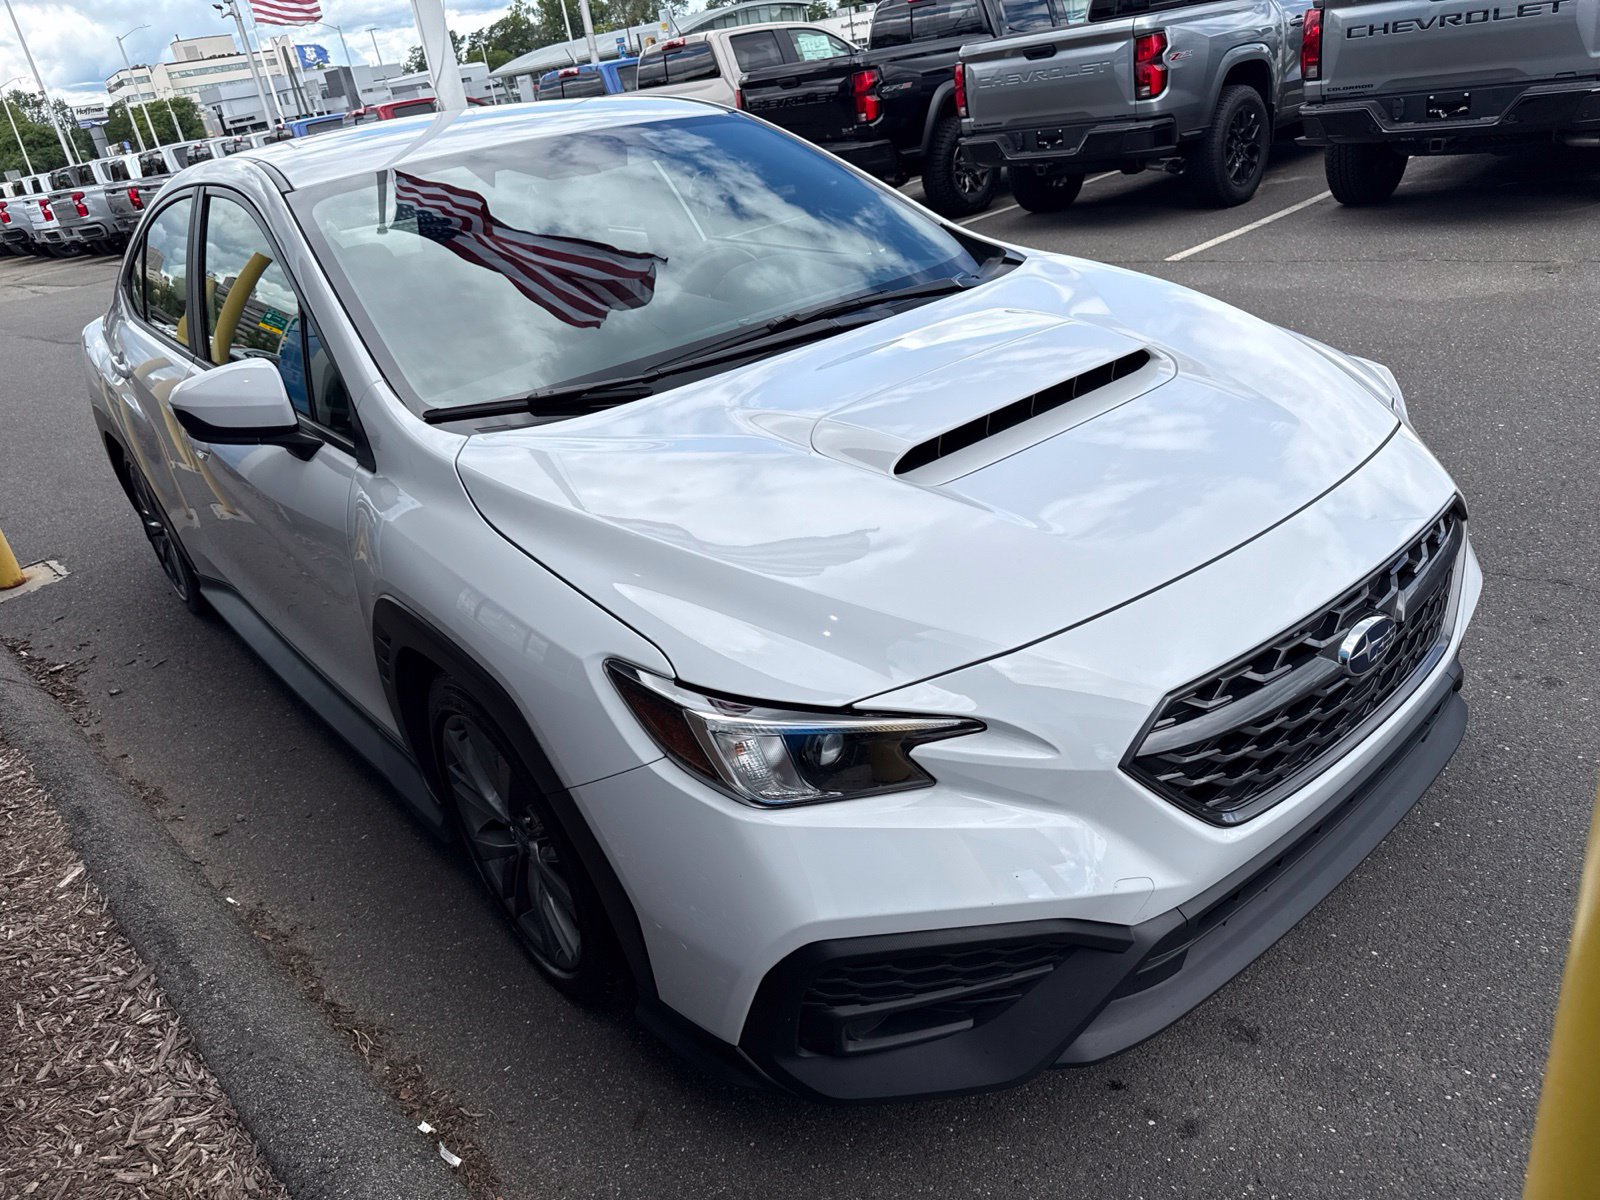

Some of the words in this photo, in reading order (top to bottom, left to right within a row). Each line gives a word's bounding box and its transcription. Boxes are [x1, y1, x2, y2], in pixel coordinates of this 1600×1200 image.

[1346, 0, 1571, 40] CHEVROLET
[979, 62, 1110, 88] CHEVROLET
[1326, 83, 1374, 92] COLORADO
[76, 106, 104, 115] Hoffman
